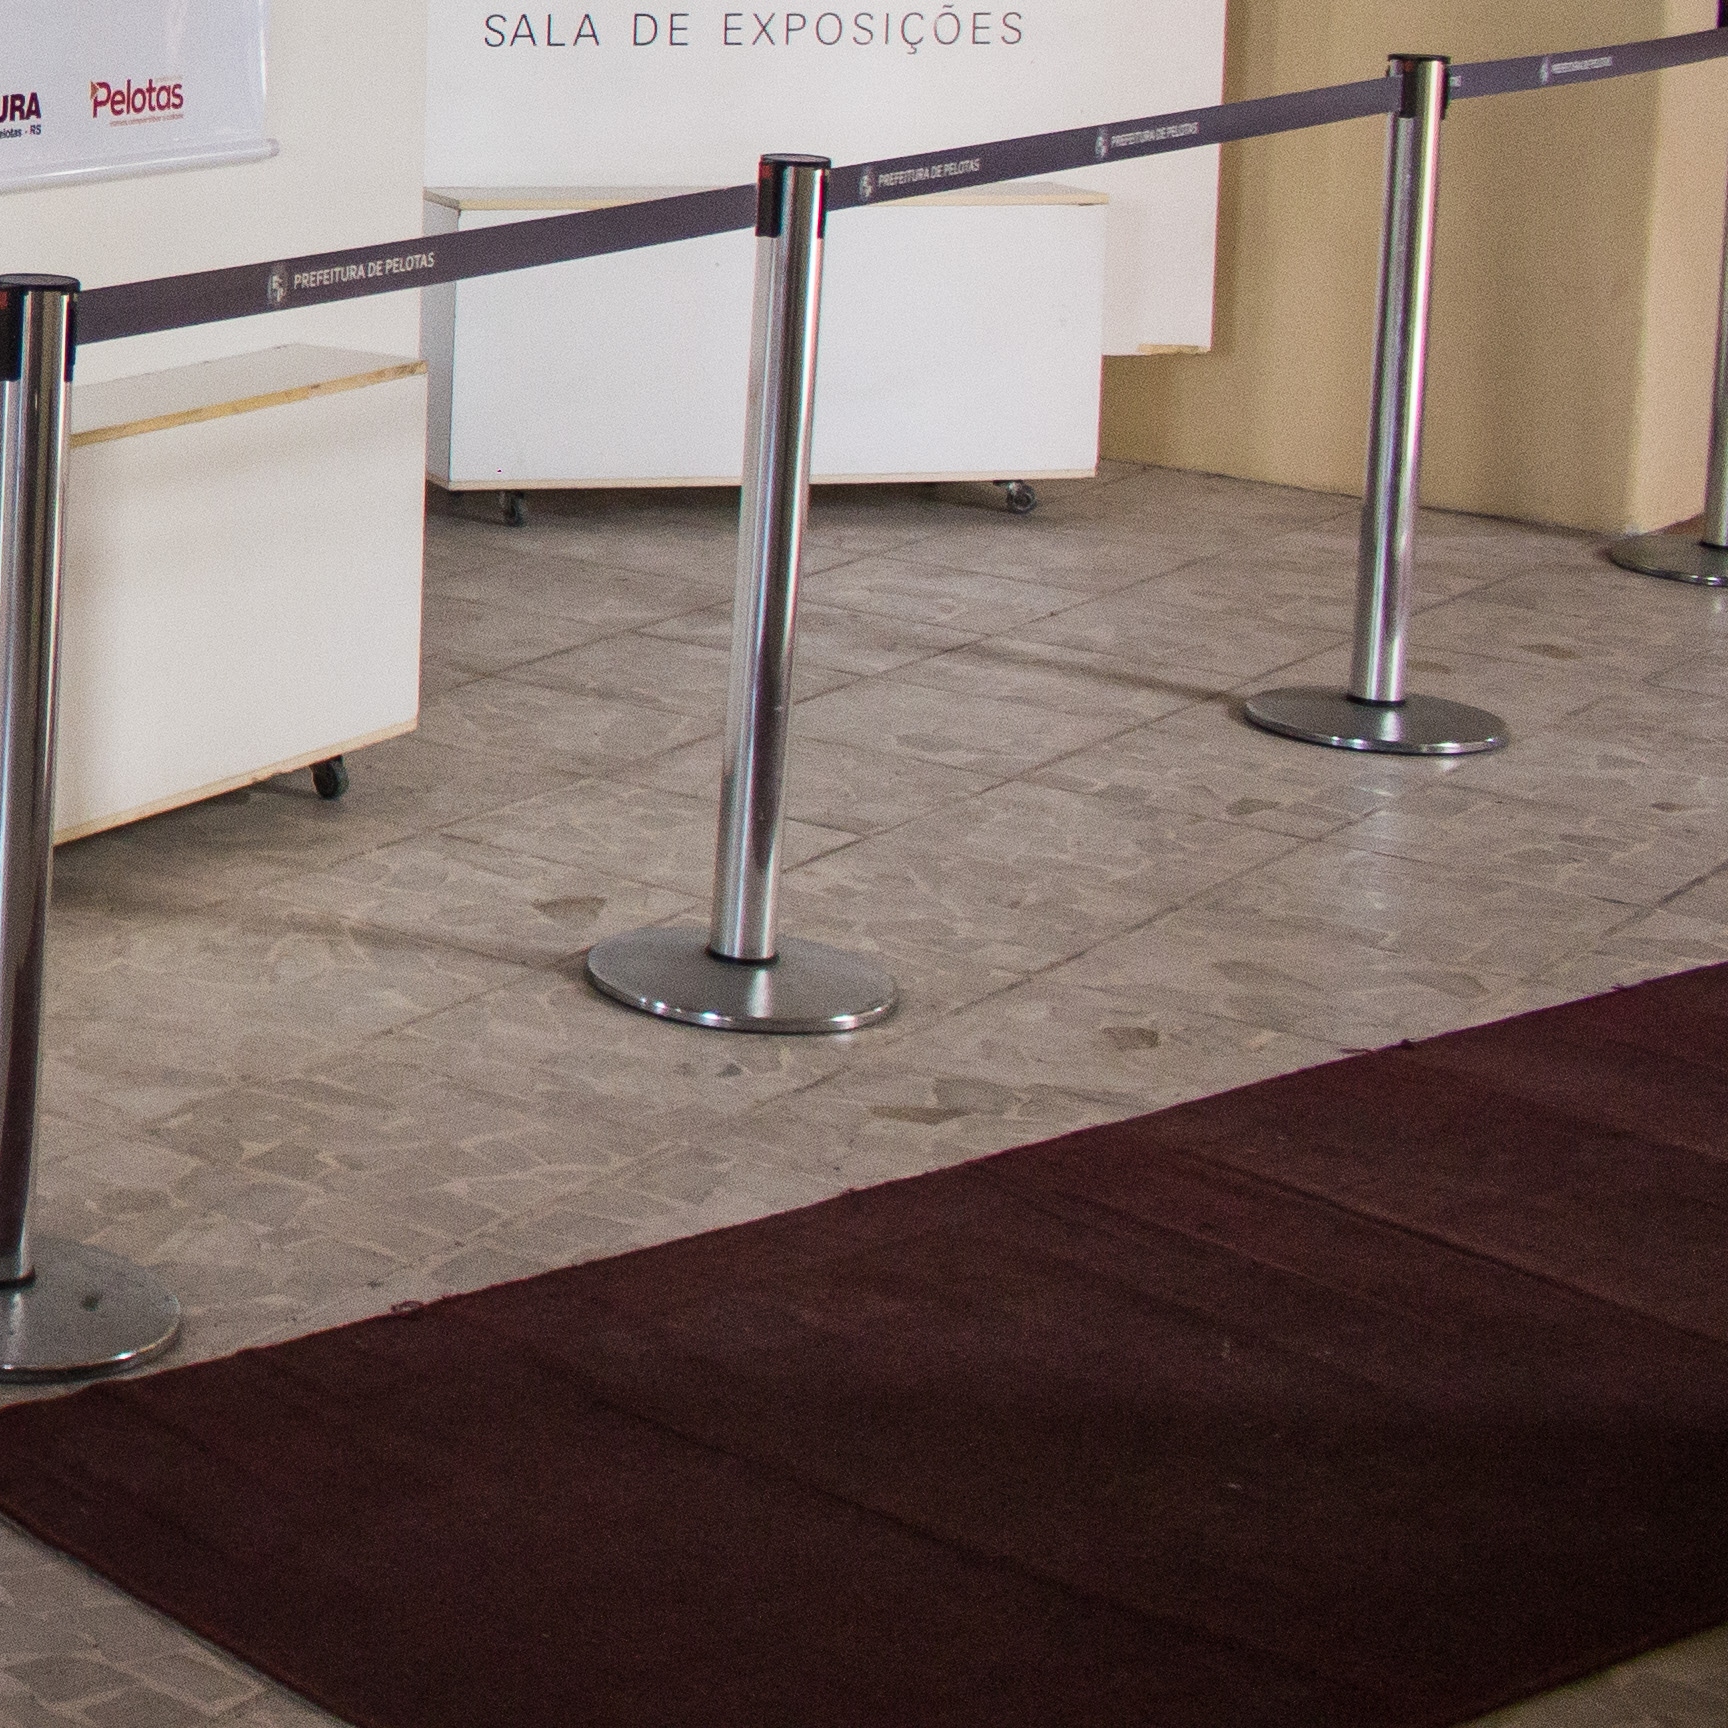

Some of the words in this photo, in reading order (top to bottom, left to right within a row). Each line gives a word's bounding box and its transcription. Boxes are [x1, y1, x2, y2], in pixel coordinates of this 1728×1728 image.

[483, 12, 601, 49] SALA
[632, 12, 690, 48] DE
[722, 3, 1023, 56] EXPOSIÇÕES
[91, 78, 184, 119] Pelotas
[293, 263, 366, 290] PREFEITURA
[368, 259, 383, 278] DE
[385, 251, 436, 273] PELOTAS
